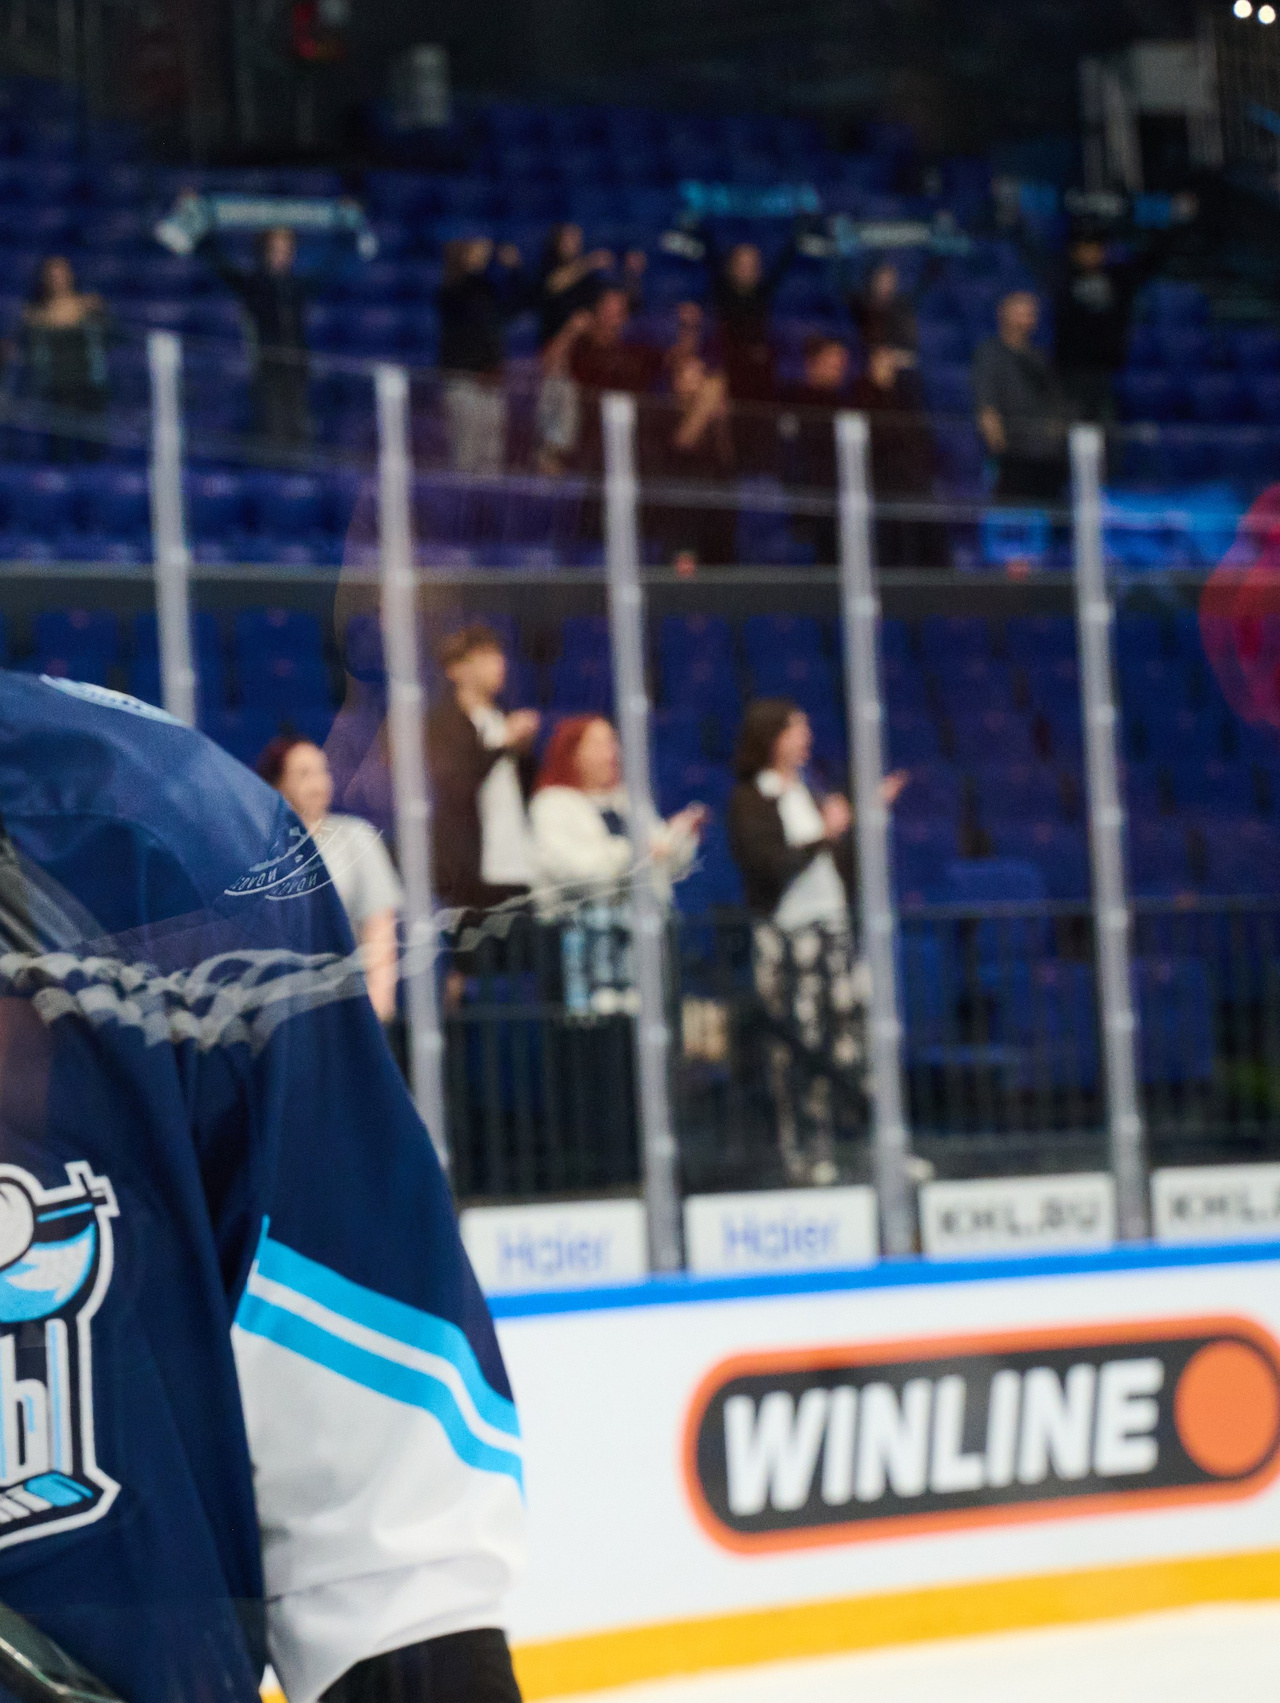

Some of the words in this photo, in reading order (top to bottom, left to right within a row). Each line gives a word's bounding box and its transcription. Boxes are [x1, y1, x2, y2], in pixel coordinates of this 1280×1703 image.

[498, 1218, 611, 1279] Haier
[724, 1203, 837, 1264] Haier
[723, 1357, 1165, 1517] WINLINE
